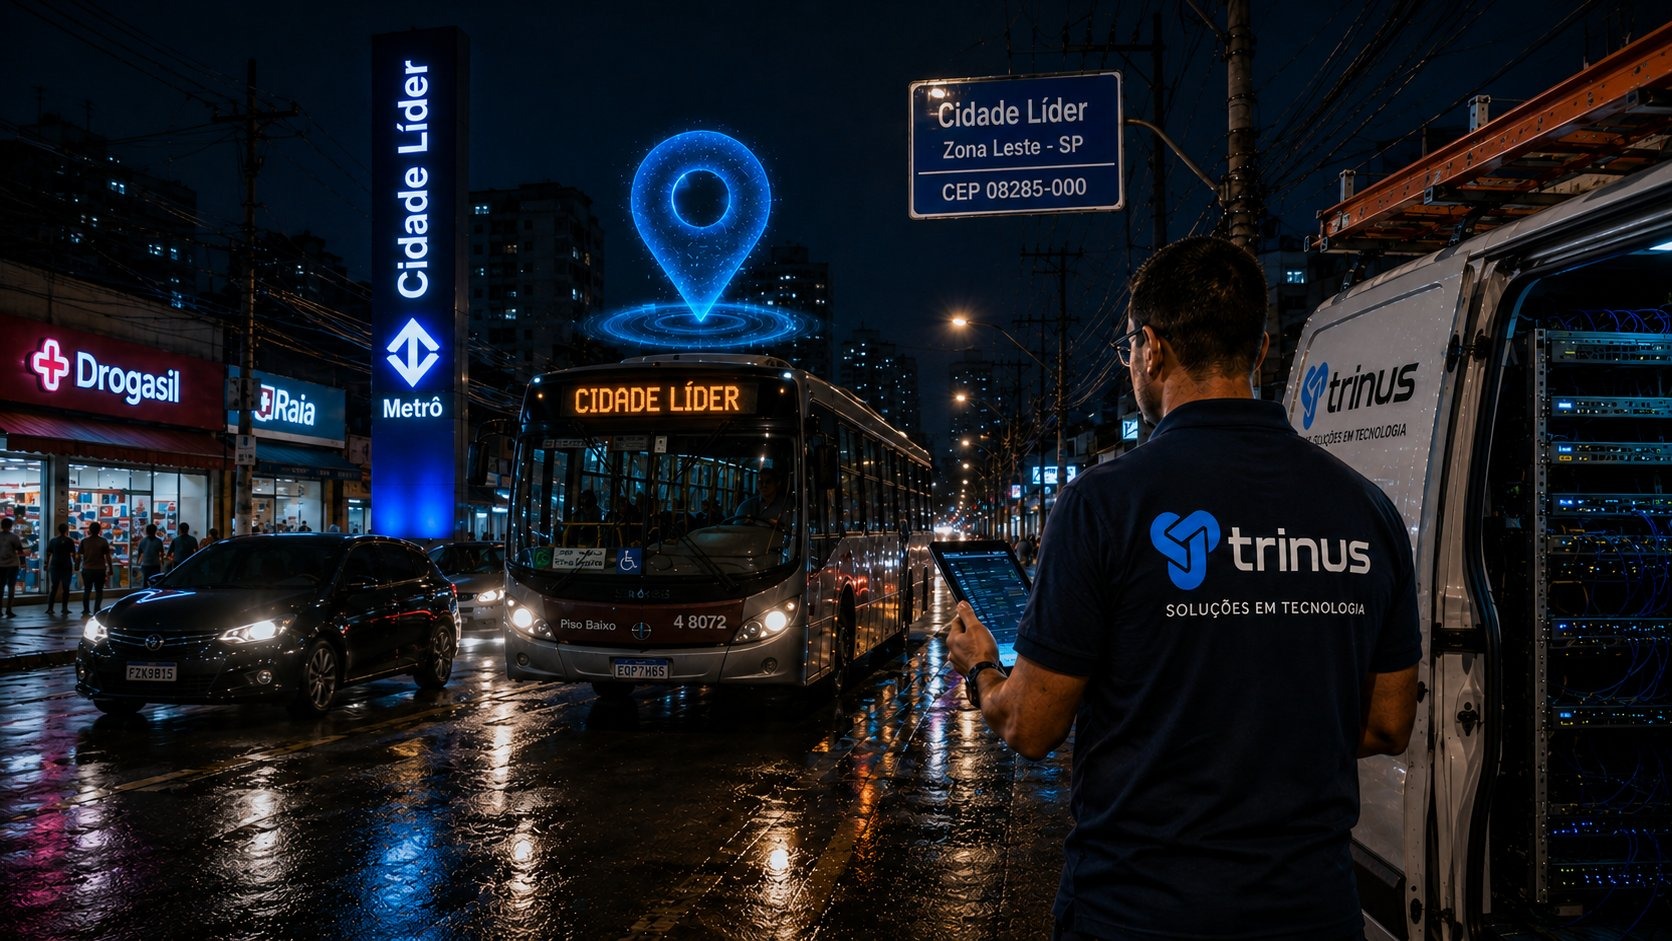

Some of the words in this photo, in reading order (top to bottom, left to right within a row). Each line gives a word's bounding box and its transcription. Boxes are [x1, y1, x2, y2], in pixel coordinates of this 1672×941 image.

[396, 59, 429, 154] Líder
[938, 100, 1020, 128] Cidade
[1027, 96, 1088, 124] Líder
[943, 141, 987, 159] Zona
[993, 138, 1041, 157] Leste
[1059, 135, 1084, 153] SP
[942, 182, 981, 201] CEP
[986, 177, 1087, 199] 08285-000
[397, 165, 429, 299] Cidade
[77, 351, 180, 406] Drogasil
[1326, 362, 1420, 414] trinus
[274, 388, 316, 426] Raia
[383, 397, 443, 418] Metrô
[575, 386, 661, 414] CIDADE
[670, 380, 740, 412] LÍDER
[1343, 430, 1355, 443] EM
[1355, 423, 1407, 441] TECNOLOGIA
[1228, 526, 1372, 575] trinus
[560, 618, 583, 630] Piso
[585, 619, 617, 631] Baixo
[673, 615, 684, 629] 4
[688, 615, 727, 630] 8072
[1166, 599, 1250, 619] SOLUÇÕES
[1255, 601, 1276, 615] EM
[1281, 601, 1365, 615] TECNOLOGIA
